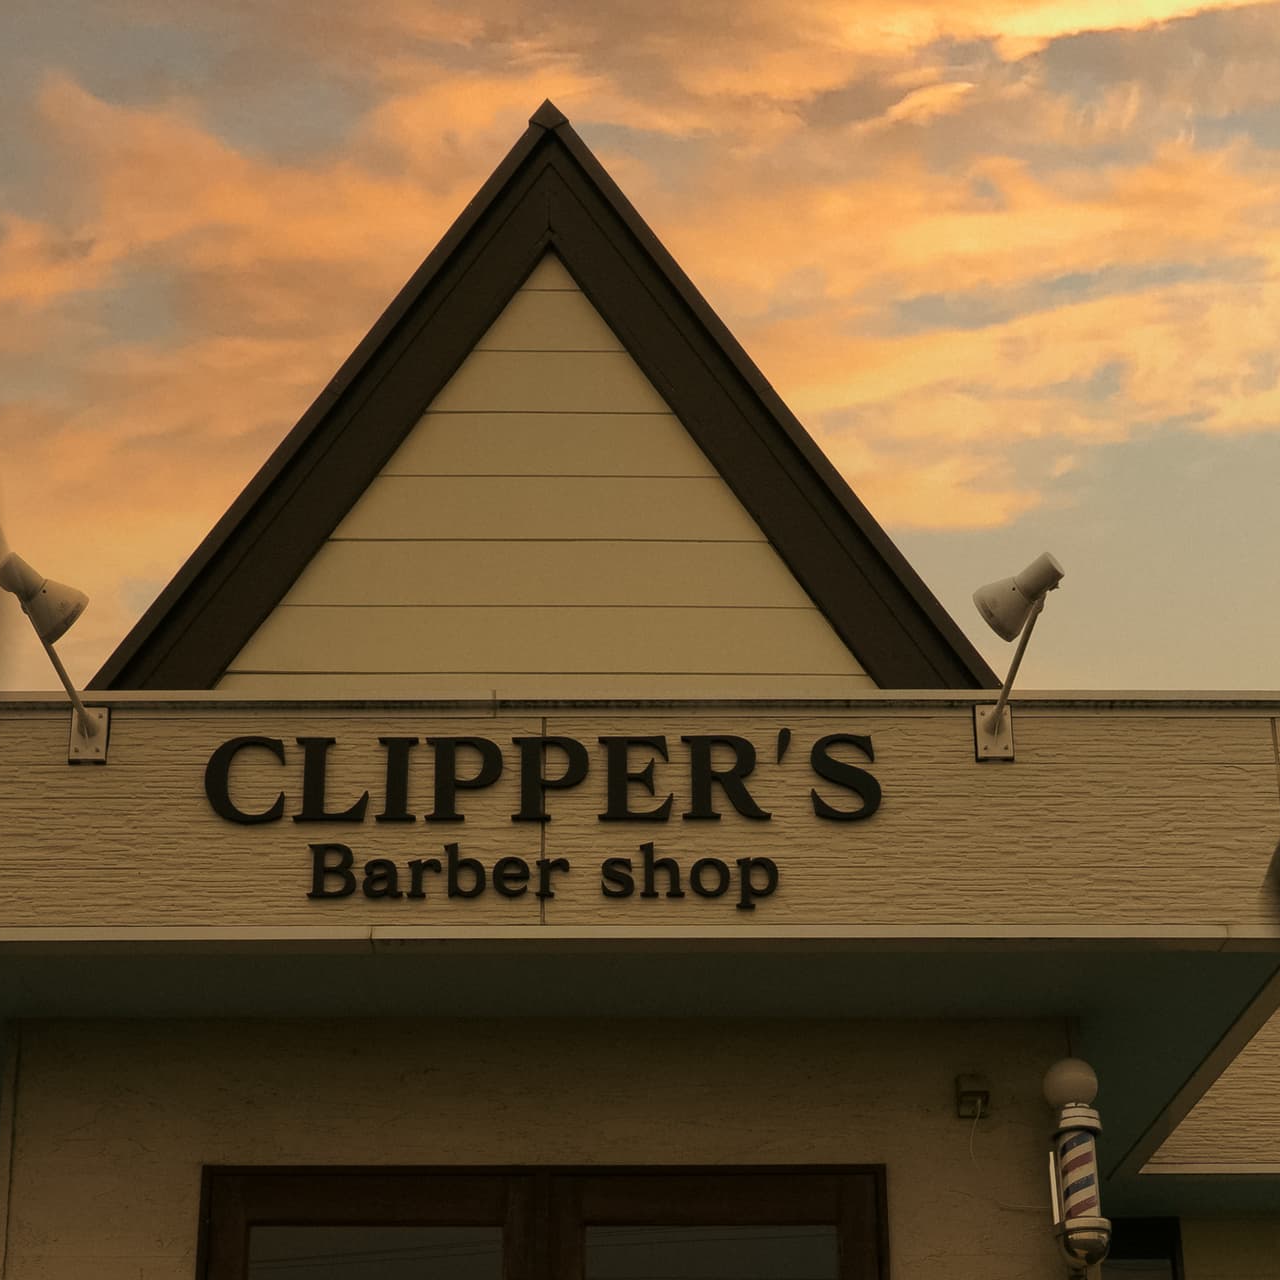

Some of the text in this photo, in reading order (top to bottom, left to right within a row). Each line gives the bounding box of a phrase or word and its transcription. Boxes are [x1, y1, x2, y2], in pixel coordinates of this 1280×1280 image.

[204, 727, 882, 825] CLIPPER'S
[306, 842, 779, 910] Barber shop
